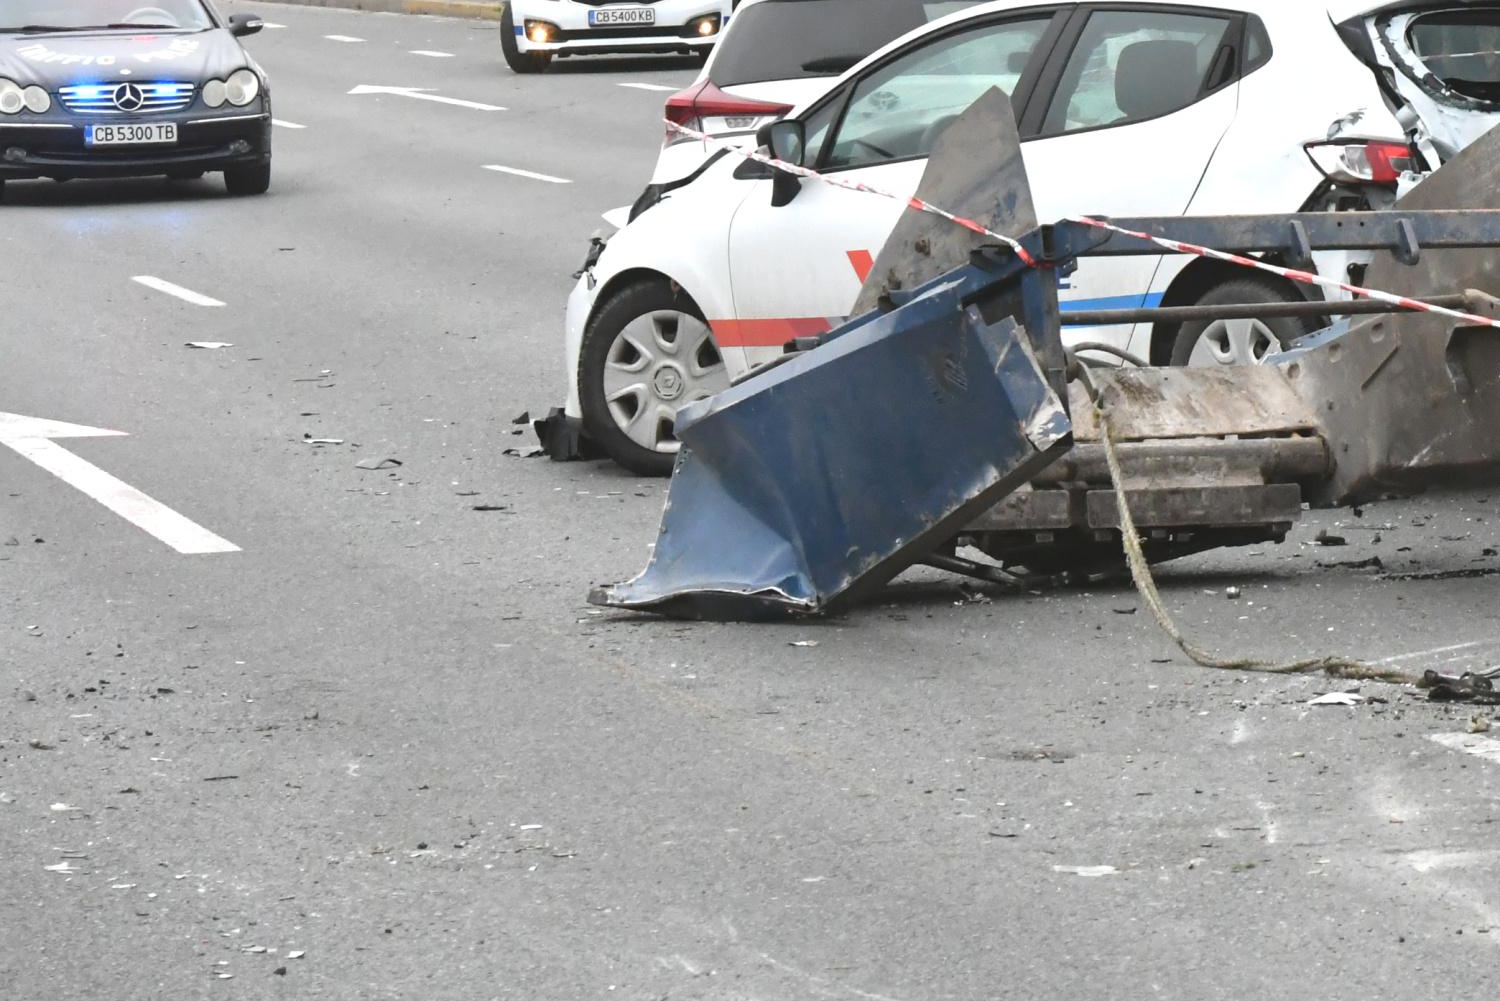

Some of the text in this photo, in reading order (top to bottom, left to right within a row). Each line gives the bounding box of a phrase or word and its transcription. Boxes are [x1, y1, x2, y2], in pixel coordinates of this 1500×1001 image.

[612, 10, 637, 22] 5400
[95, 125, 175, 142] CB 5300 TB
